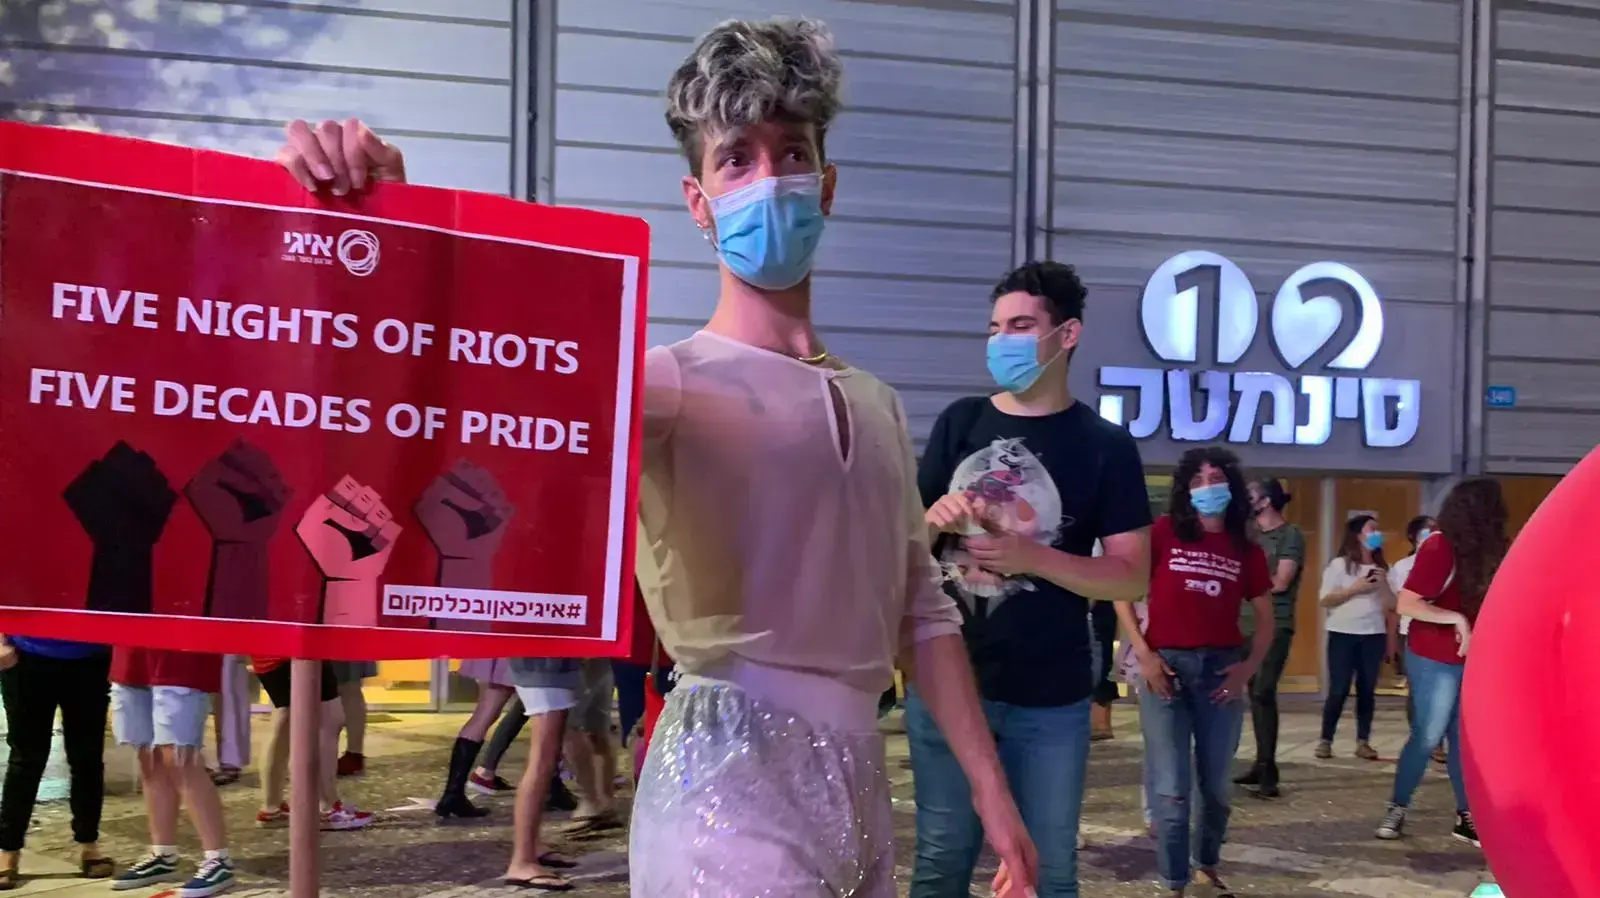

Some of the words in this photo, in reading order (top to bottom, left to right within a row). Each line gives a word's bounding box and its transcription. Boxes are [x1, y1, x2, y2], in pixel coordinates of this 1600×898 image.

[283, 231, 334, 257] איגי
[53, 283, 158, 329] FIVE
[177, 297, 358, 349] NIGHTS
[374, 319, 435, 356] OF
[450, 328, 579, 375] RIOTS
[30, 368, 136, 413] FIVE
[154, 380, 371, 434] DECADES
[387, 403, 447, 440] OF
[461, 411, 590, 455] PRIDE
[1099, 366, 1421, 447] סינמטק
[388, 593, 582, 619] #איגיכאןובכלמקום
